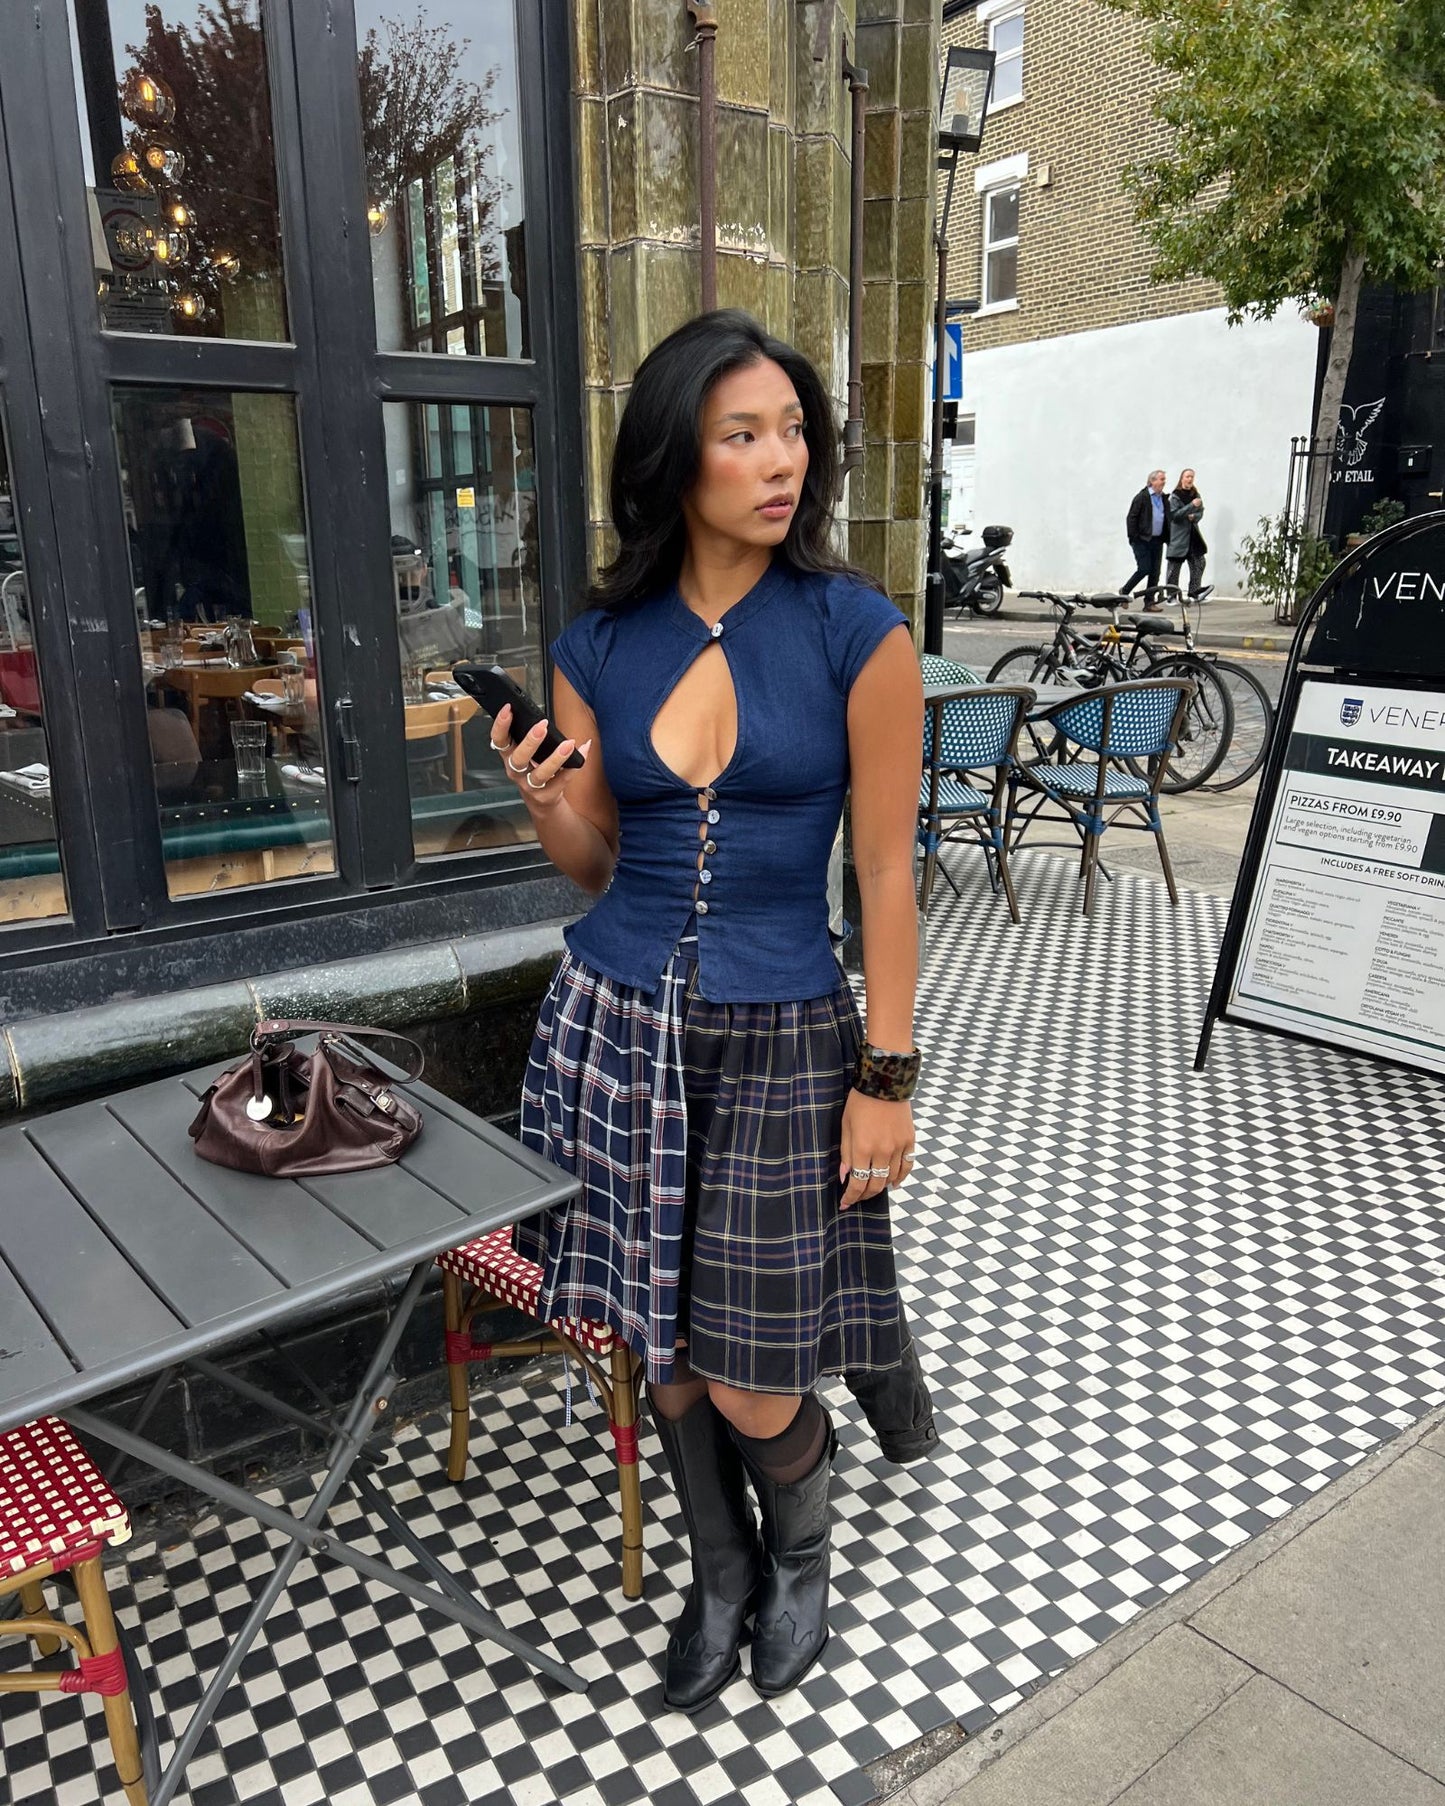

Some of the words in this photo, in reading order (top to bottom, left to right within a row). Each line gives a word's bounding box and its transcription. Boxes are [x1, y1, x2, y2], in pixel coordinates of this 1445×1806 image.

[1328, 748, 1440, 778] TAKEAWAY
[1290, 795, 1330, 810] PIZZAS
[1332, 802, 1368, 818] FROM
[1371, 808, 1402, 822] £9.90
[1284, 824, 1296, 832] and
[1298, 827, 1318, 840] vegan
[1319, 829, 1345, 841] options
[1346, 835, 1374, 848] starting
[1375, 838, 1393, 849] from
[1395, 842, 1418, 853] £9.90
[1286, 816, 1304, 828] Large
[1306, 820, 1338, 832] selection,
[1340, 824, 1373, 839] including
[1374, 830, 1412, 844] vegetarian
[1320, 857, 1364, 872] INCLUDES
[1364, 865, 1371, 874] A
[1373, 867, 1395, 878] FREE
[1397, 872, 1420, 883] SOFT
[1421, 876, 1445, 888] DRIN
